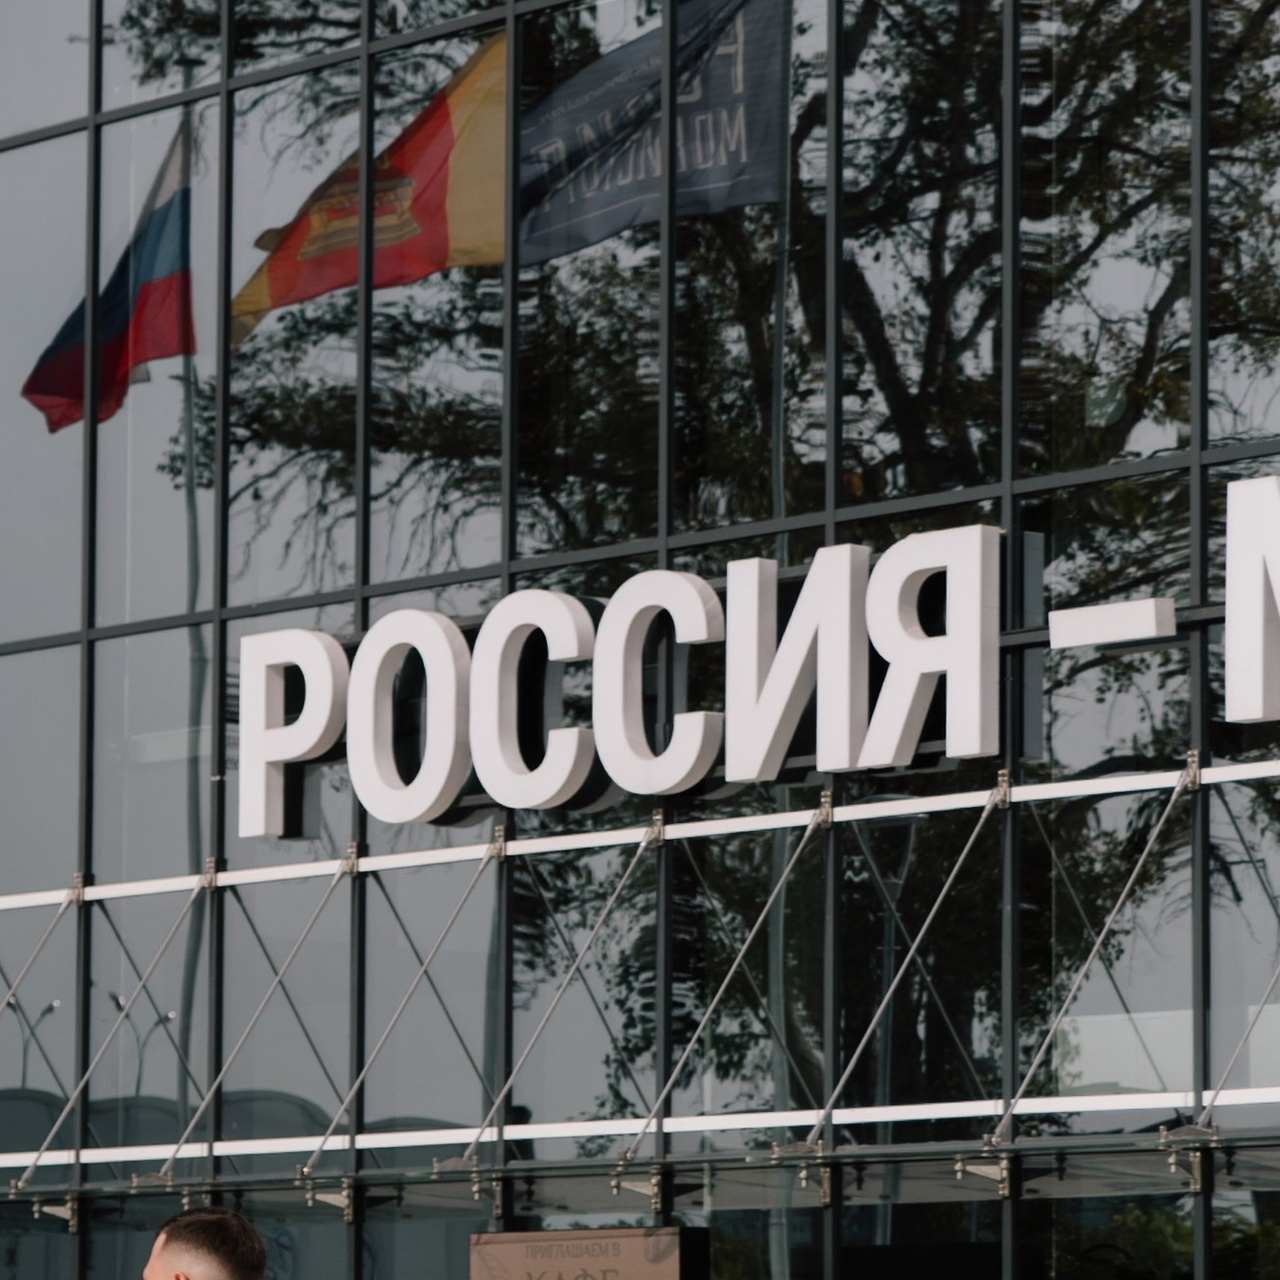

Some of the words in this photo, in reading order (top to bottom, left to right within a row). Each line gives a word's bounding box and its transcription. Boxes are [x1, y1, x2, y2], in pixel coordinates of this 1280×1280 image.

[238, 524, 1001, 838] РОССИЯ
[525, 1243, 609, 1259] ПРИГЛАШАЕМ
[613, 1242, 621, 1257] В
